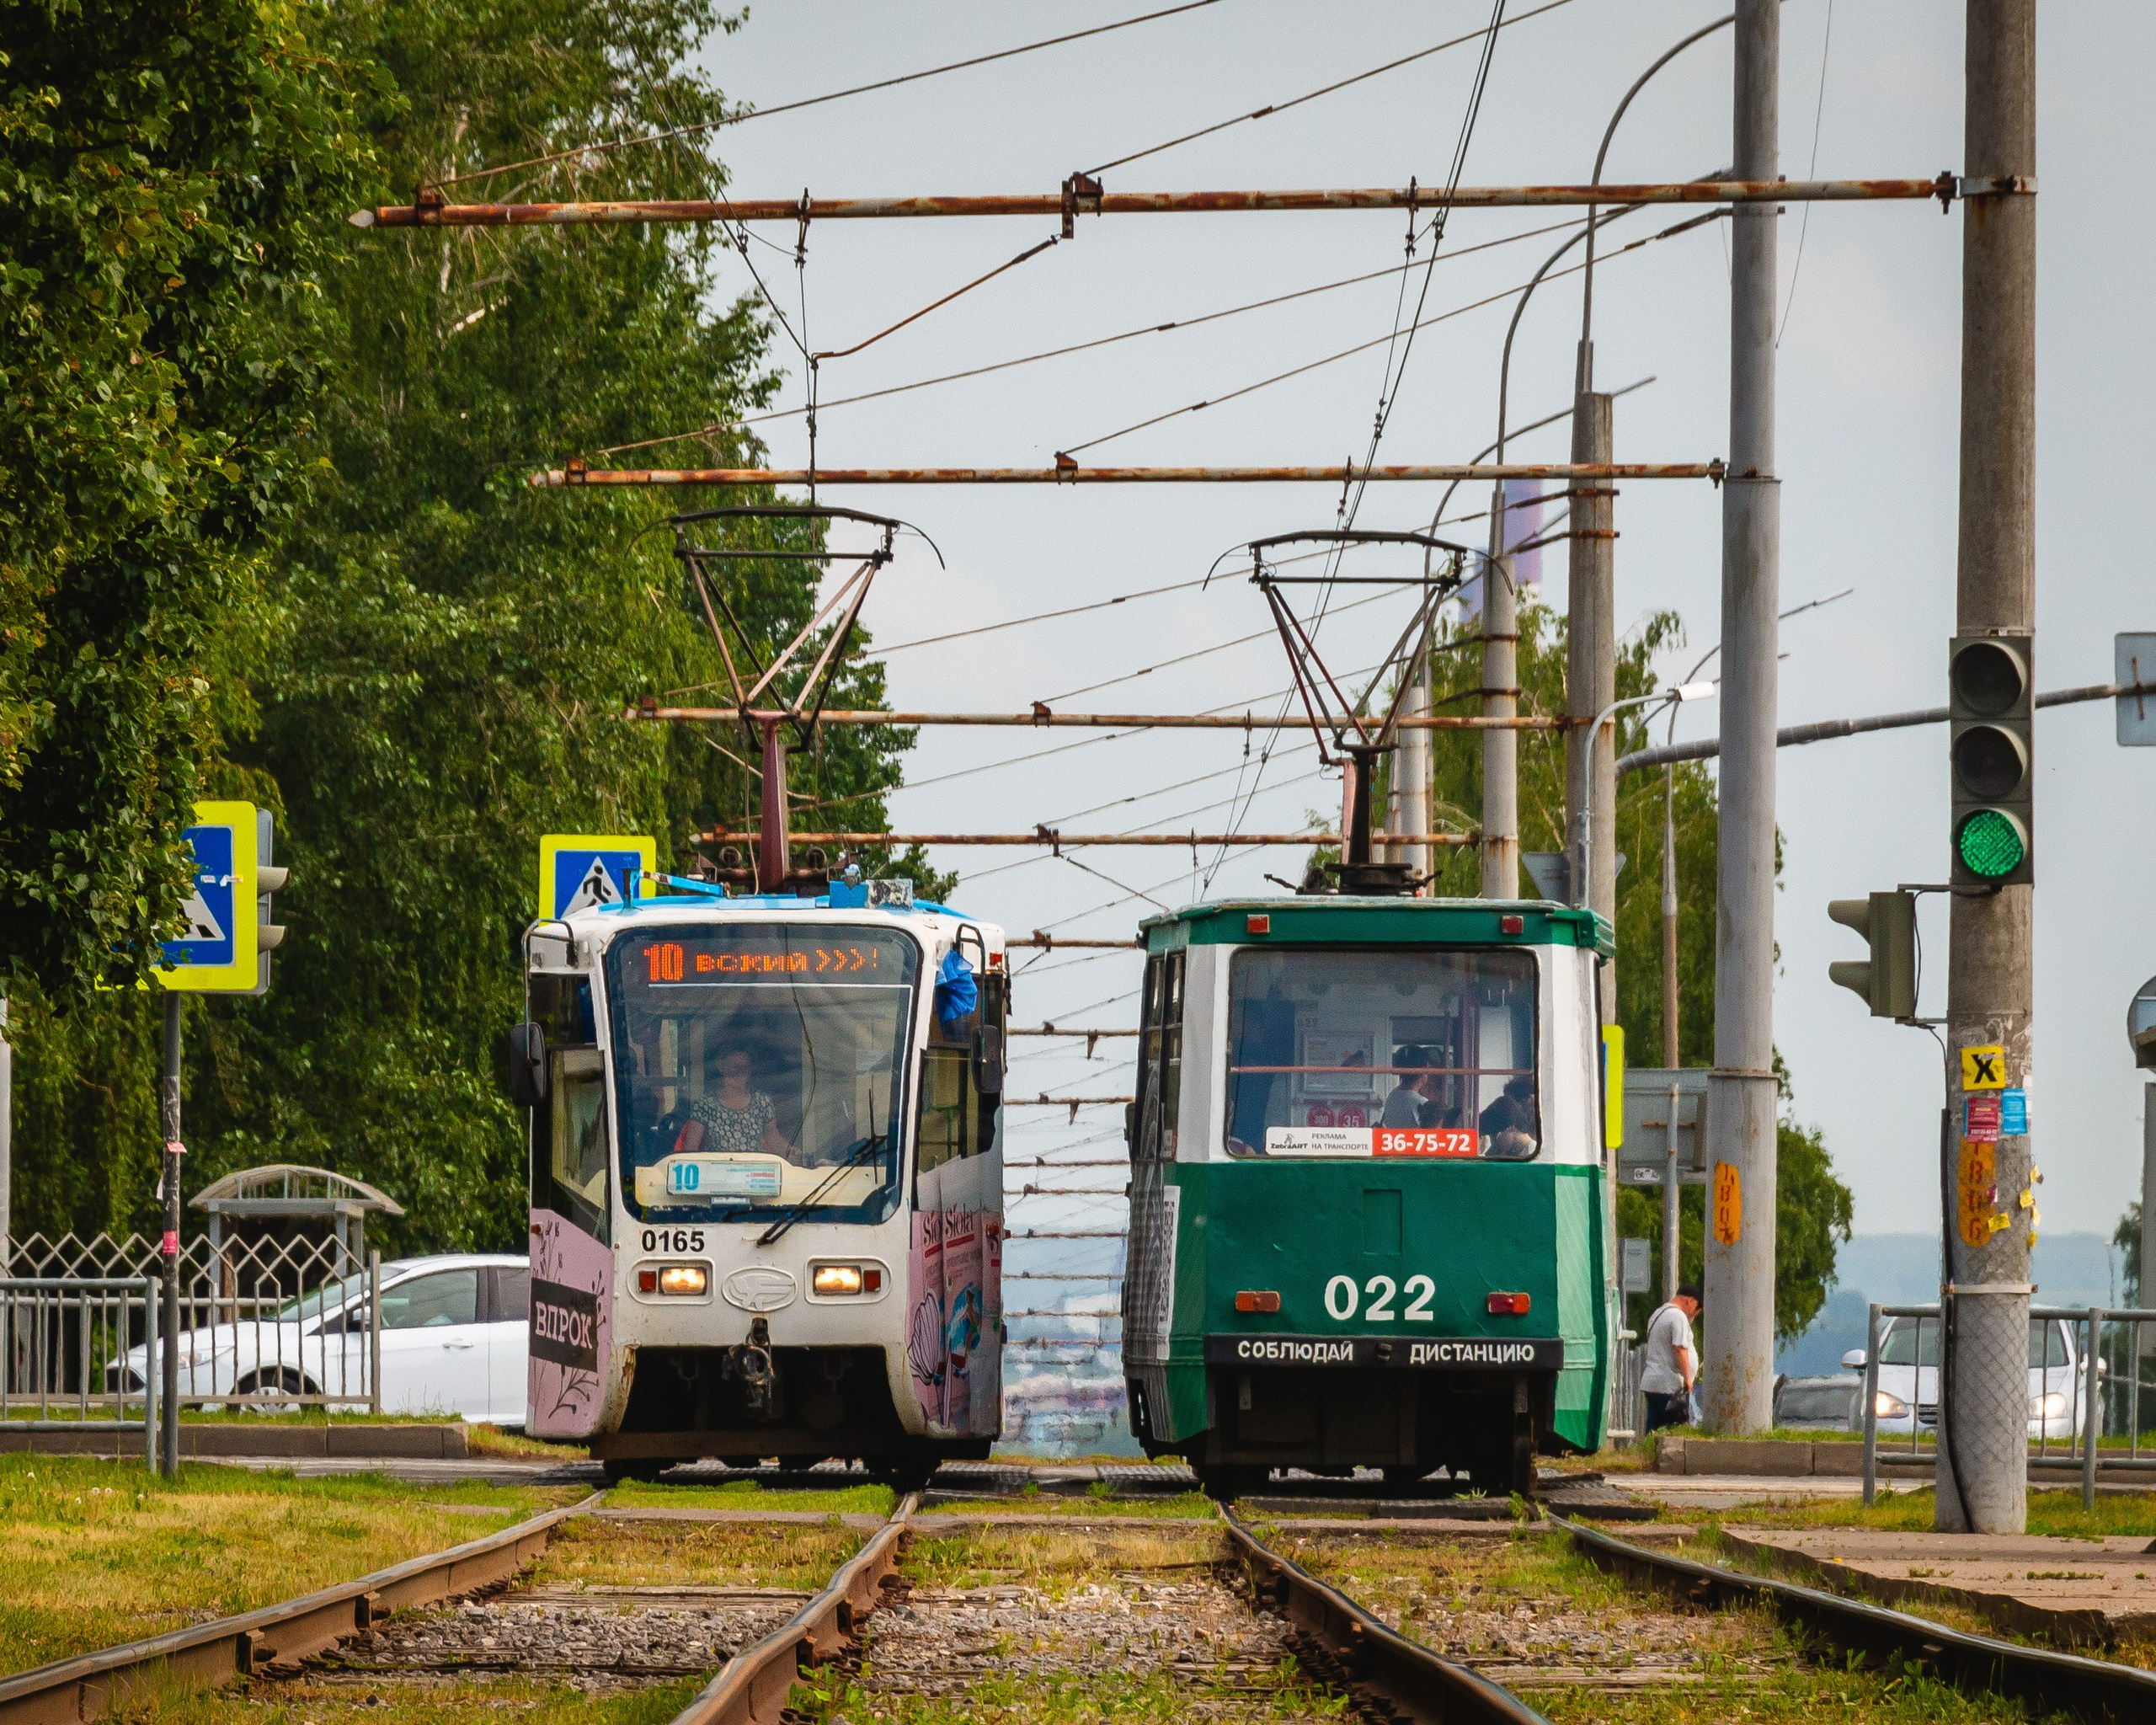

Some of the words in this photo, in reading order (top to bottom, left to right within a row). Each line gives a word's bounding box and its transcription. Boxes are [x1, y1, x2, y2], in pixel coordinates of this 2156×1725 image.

[643, 943, 684, 981] 10
[1381, 1133, 1470, 1151] 36-75-72
[673, 1163, 700, 1190] 10
[642, 1229, 705, 1252] 0165
[1324, 1274, 1435, 1321] 022
[535, 1300, 593, 1349] ВПРОК
[1237, 1340, 1353, 1363] СОБЛЮДАЙ
[1410, 1343, 1534, 1365] ДИСТАНЦИЮ
